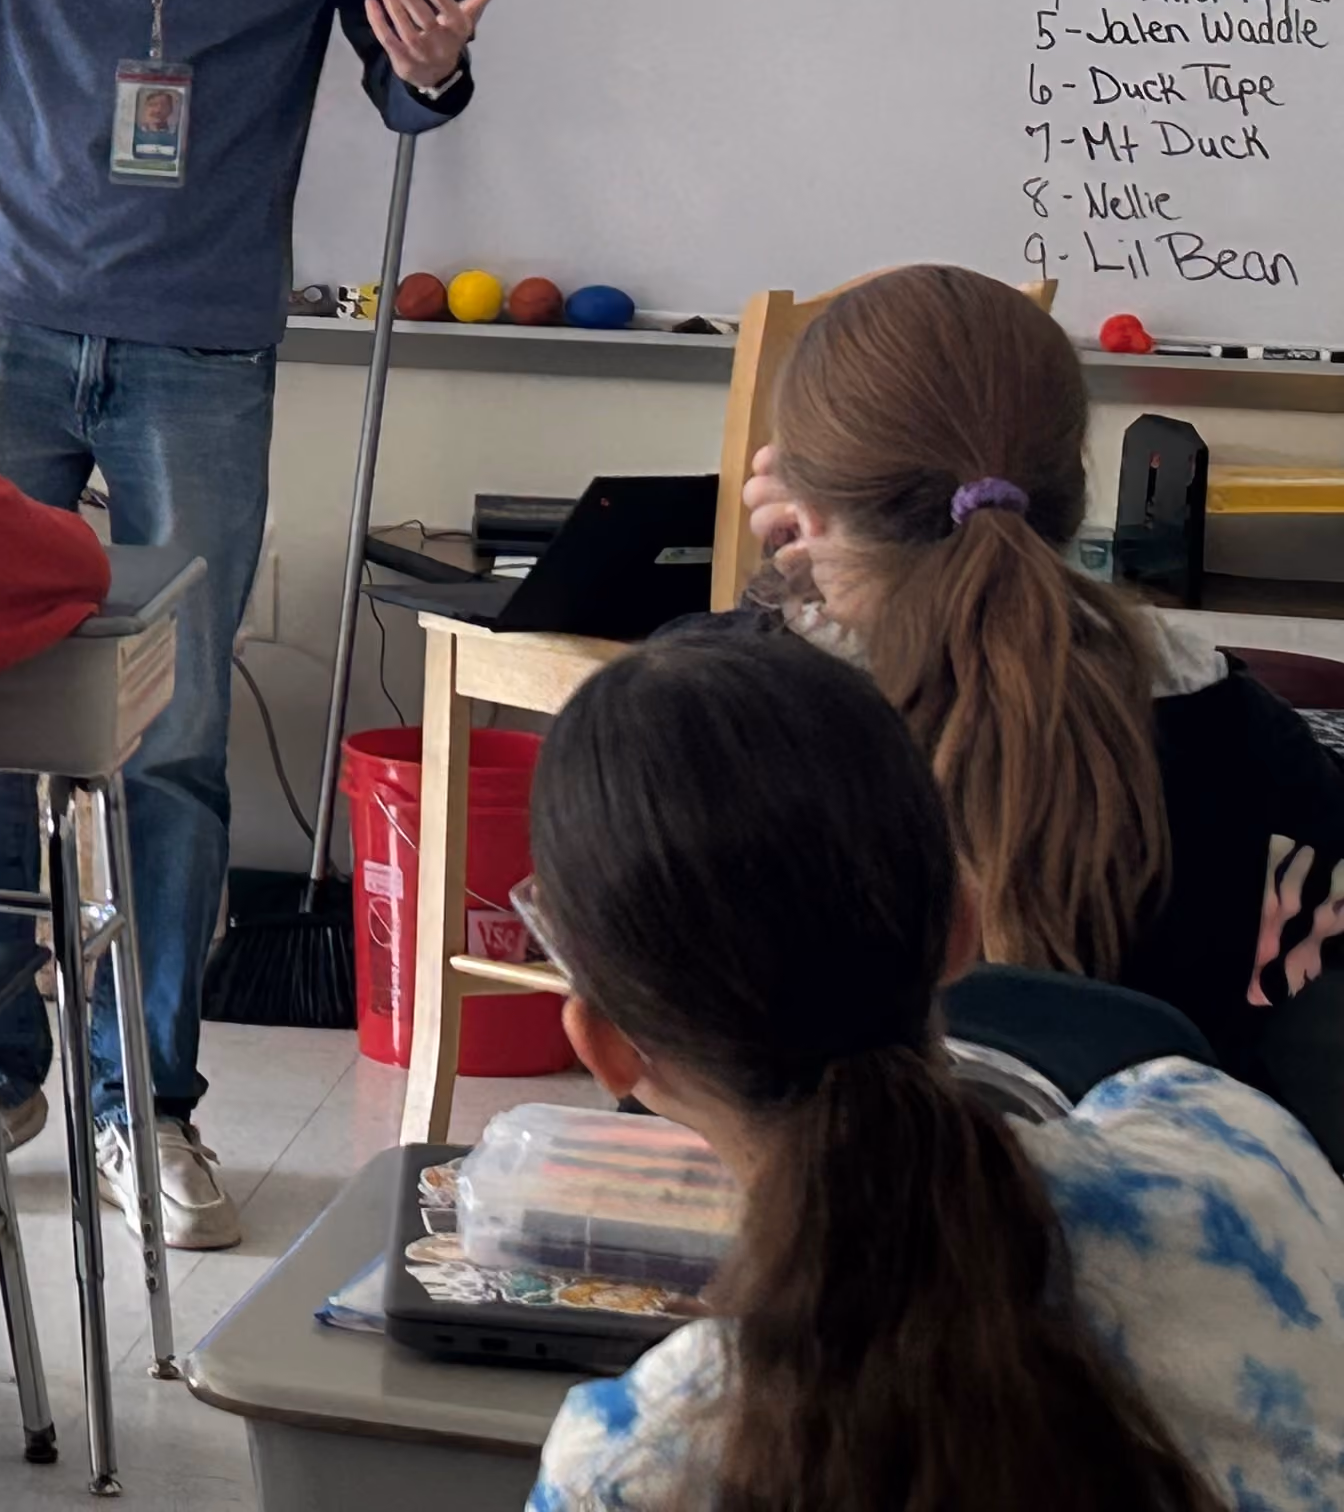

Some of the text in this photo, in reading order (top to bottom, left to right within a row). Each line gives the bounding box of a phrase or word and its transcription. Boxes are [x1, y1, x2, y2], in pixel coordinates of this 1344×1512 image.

[1202, 9, 1328, 48] Waddle
[1089, 66, 1186, 104] Duck
[1181, 63, 1285, 116] Tape
[1151, 120, 1269, 159] Duck
[1083, 182, 1182, 220] Nellie
[1083, 231, 1149, 279] Lil
[1155, 231, 1298, 286] Bean
